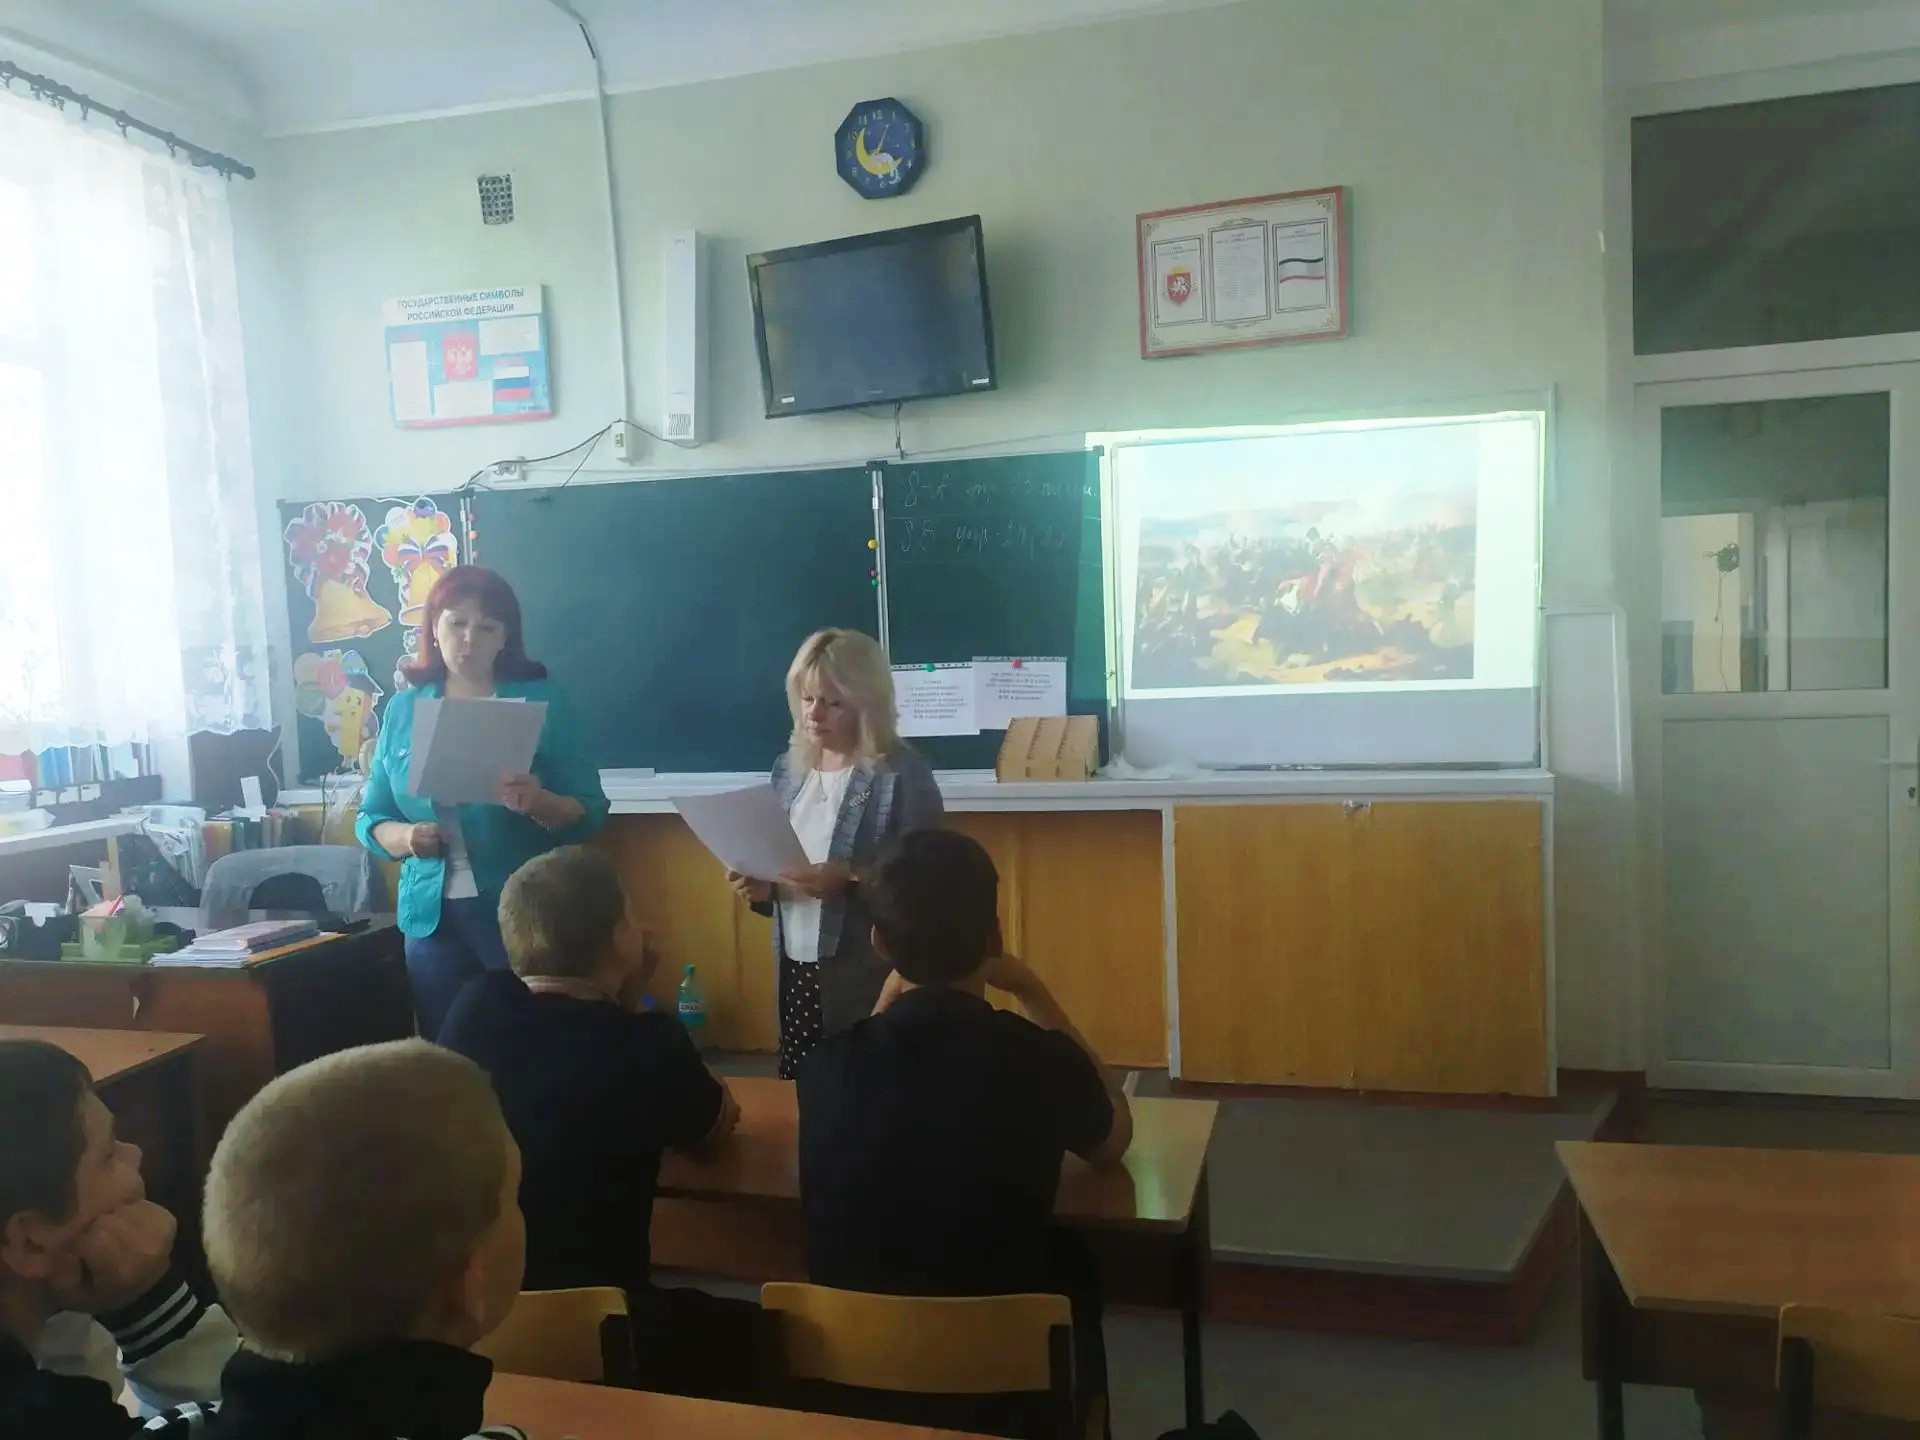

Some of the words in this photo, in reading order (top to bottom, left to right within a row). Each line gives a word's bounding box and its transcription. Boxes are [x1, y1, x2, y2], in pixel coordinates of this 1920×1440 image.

[396, 293, 479, 310] ГОСУДАРСТВЕННЫЕ
[479, 288, 525, 301] СИМВОЛЫ
[407, 307, 463, 321] РОССИЙСКОЙ
[463, 303, 515, 316] ФЕДЕРАЦИИ
